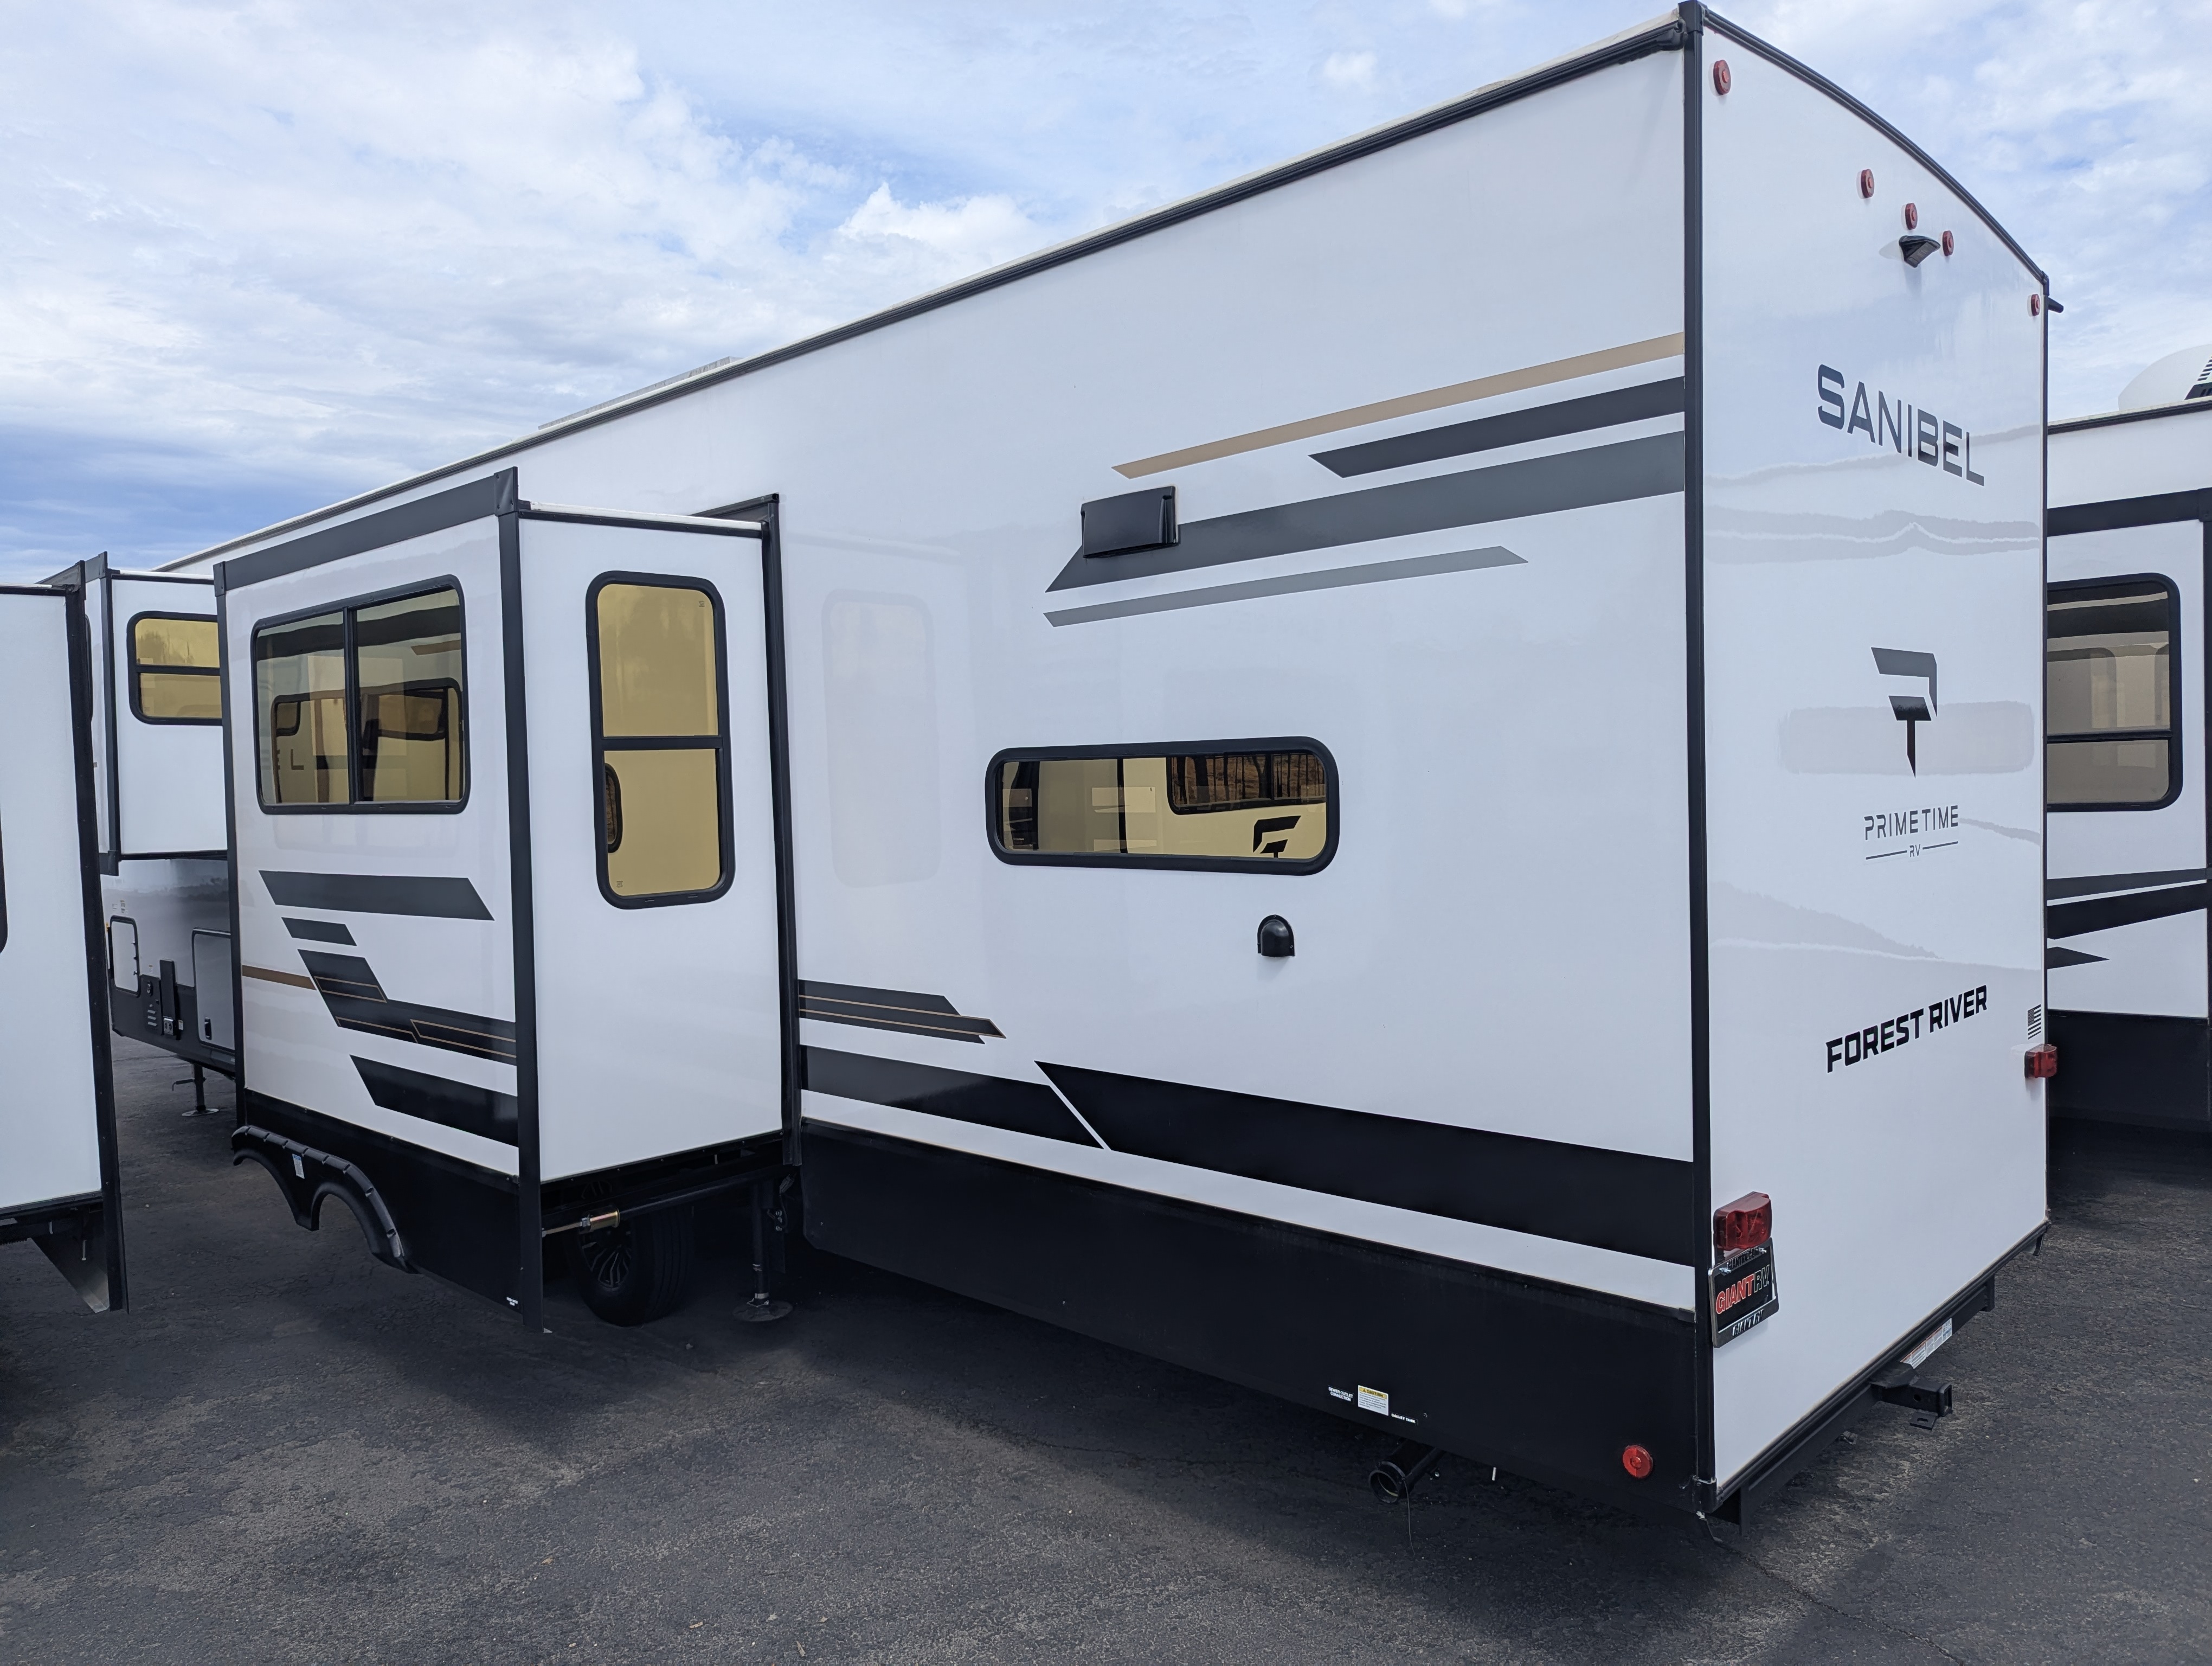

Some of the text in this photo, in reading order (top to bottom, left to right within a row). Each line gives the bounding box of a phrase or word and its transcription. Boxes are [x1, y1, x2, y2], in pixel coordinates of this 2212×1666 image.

[1817, 364, 1984, 487] SANIBEL
[1909, 843, 1921, 857] RV
[1825, 984, 1988, 1073] FOREST RIVER
